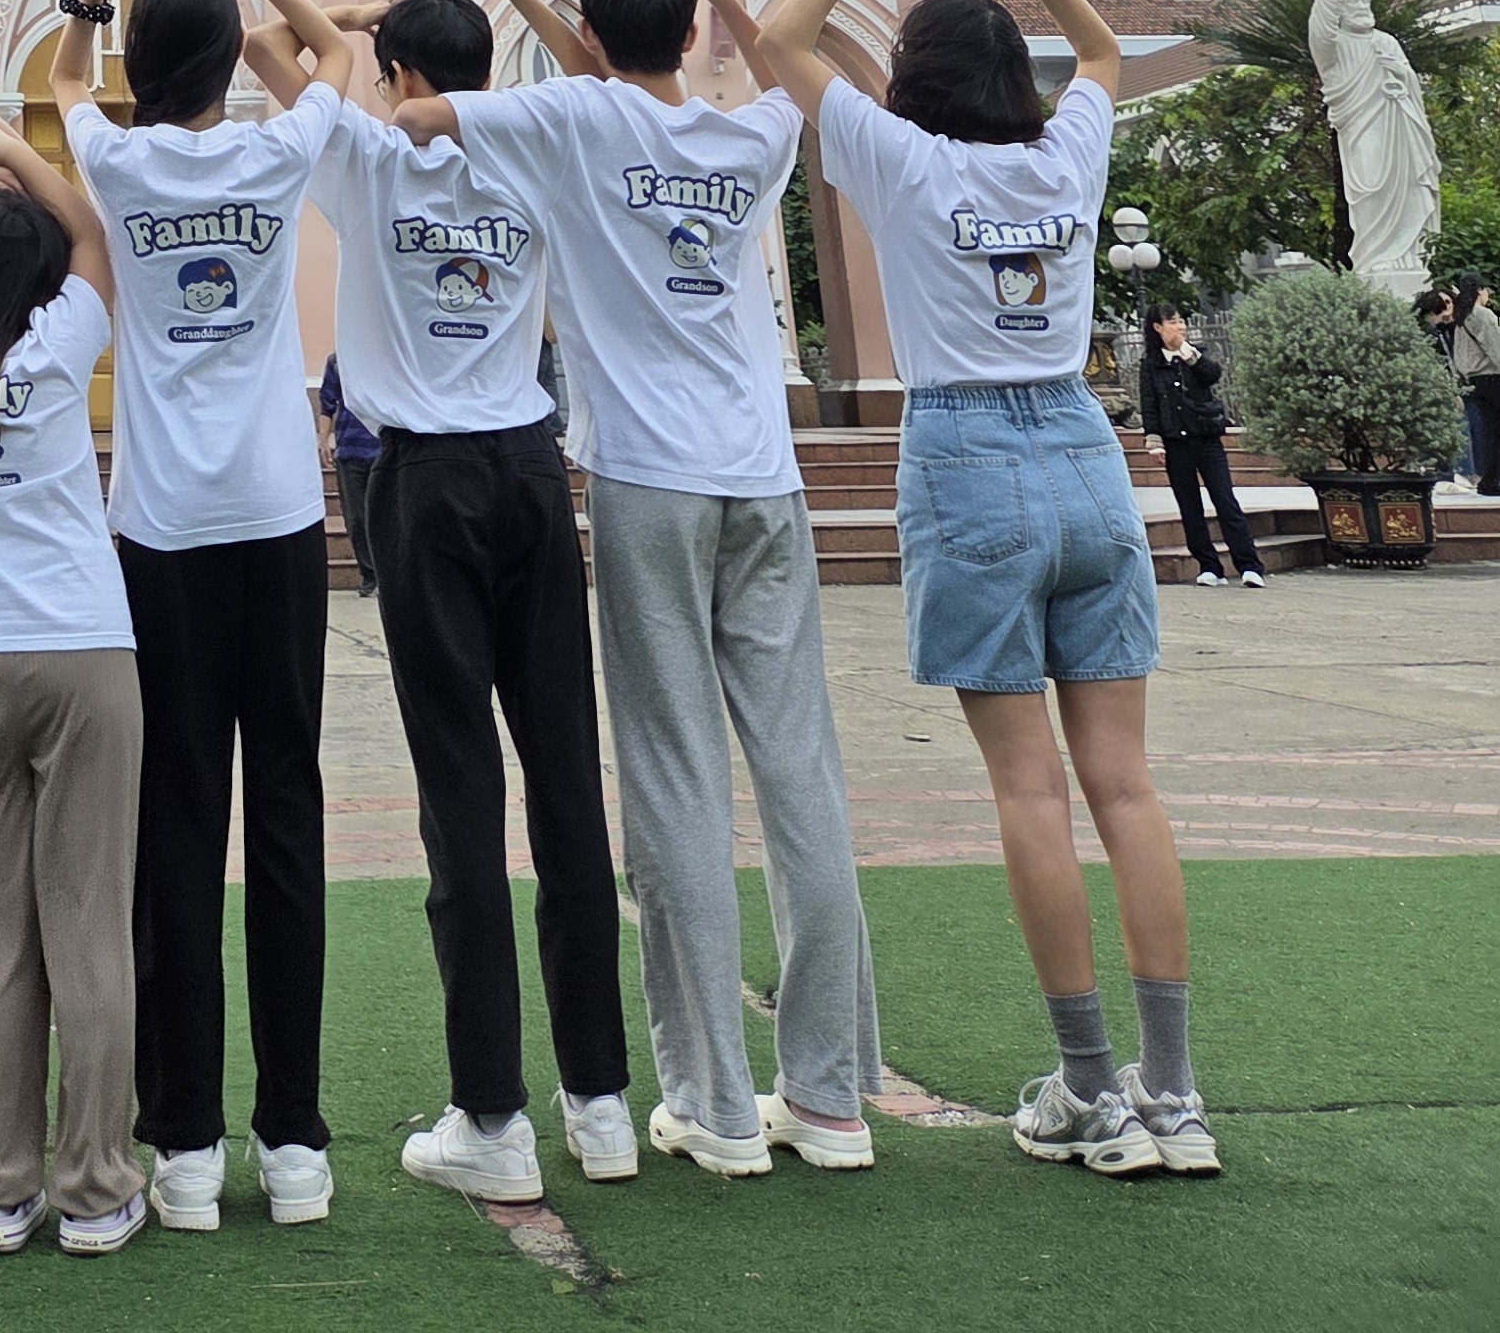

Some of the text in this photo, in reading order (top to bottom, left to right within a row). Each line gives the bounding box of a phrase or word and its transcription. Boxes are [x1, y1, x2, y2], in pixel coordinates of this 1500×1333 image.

[623, 163, 754, 224] Family
[124, 203, 282, 258] Family
[394, 215, 529, 265] Family
[671, 279, 719, 293] Grandson
[434, 322, 484, 336] Grandson
[999, 316, 1046, 329] Daughter
[173, 323, 251, 340] Granddaughter
[70, 1238, 99, 1248] crocs
